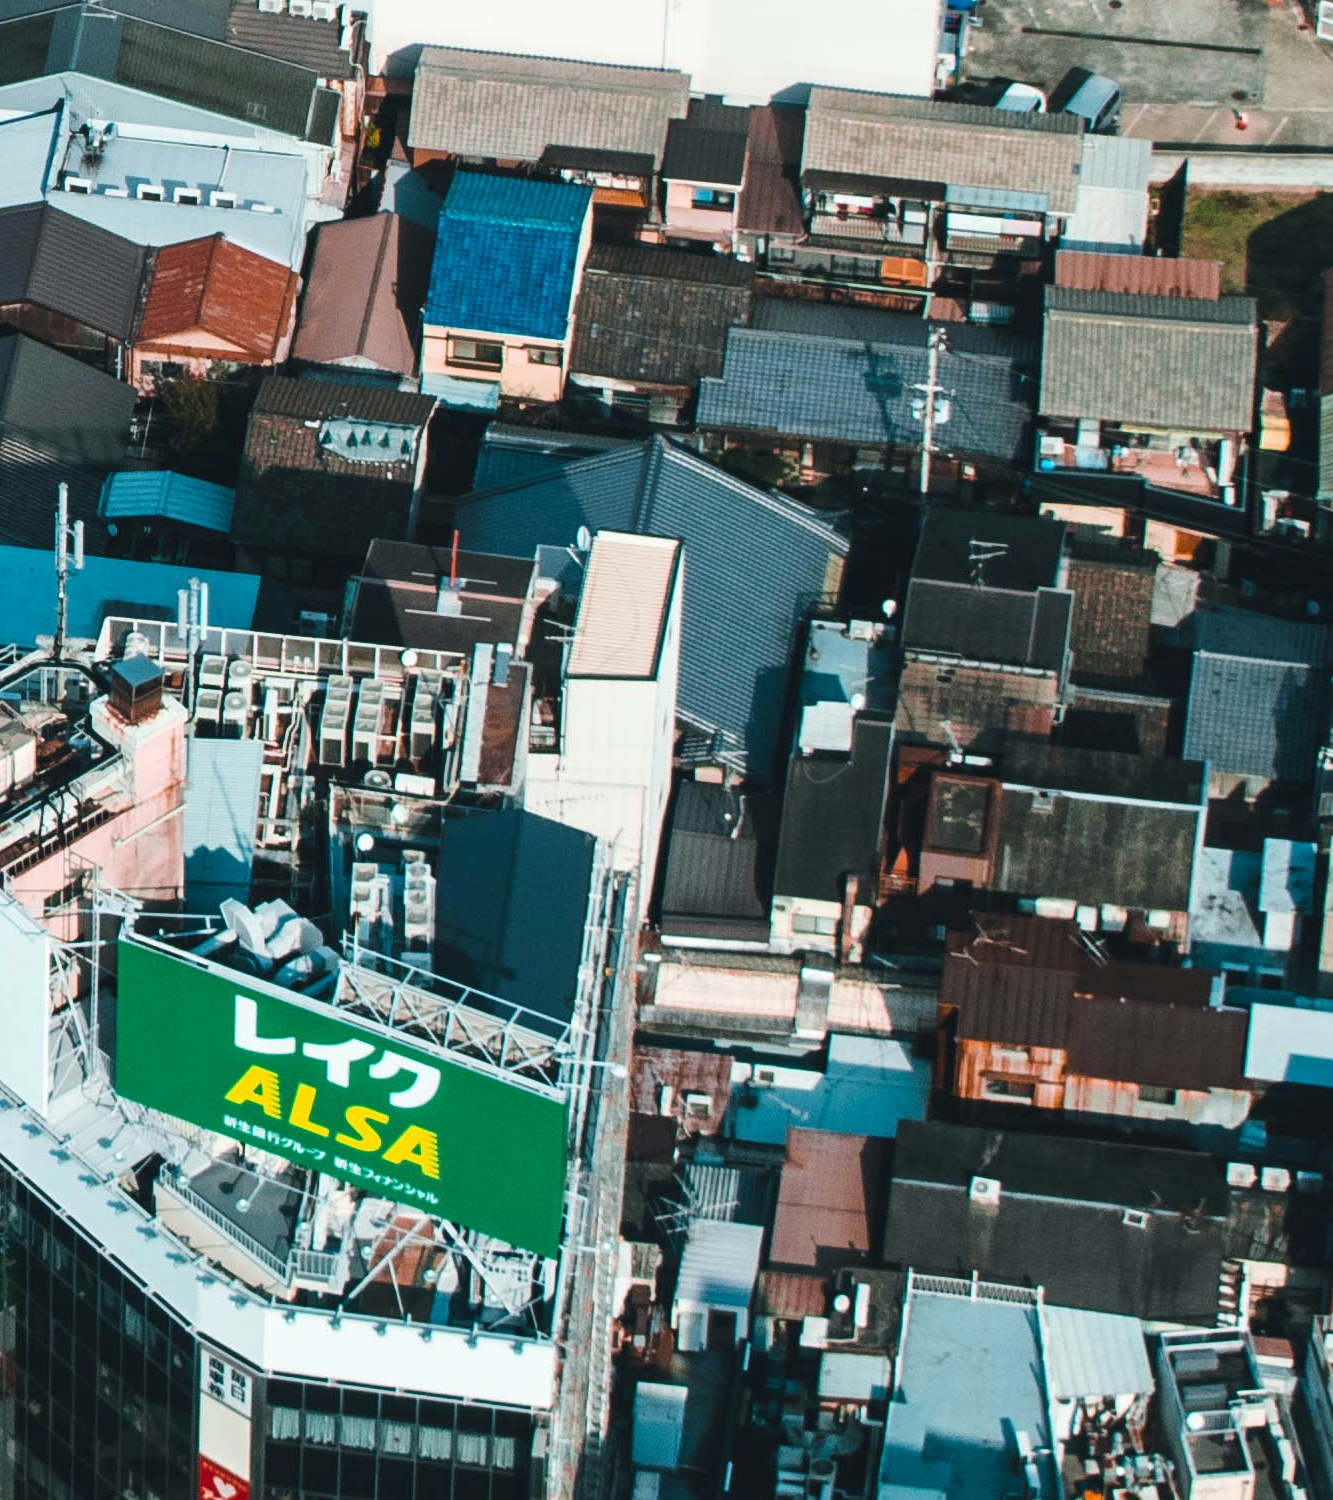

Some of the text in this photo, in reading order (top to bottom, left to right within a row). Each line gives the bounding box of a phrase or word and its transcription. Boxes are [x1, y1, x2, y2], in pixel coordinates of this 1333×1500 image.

[234, 994, 442, 1109] レイク
[223, 1065, 442, 1181] ALSA
[223, 1114, 440, 1205] 新生銀行グループ 新生フィナンシャル
